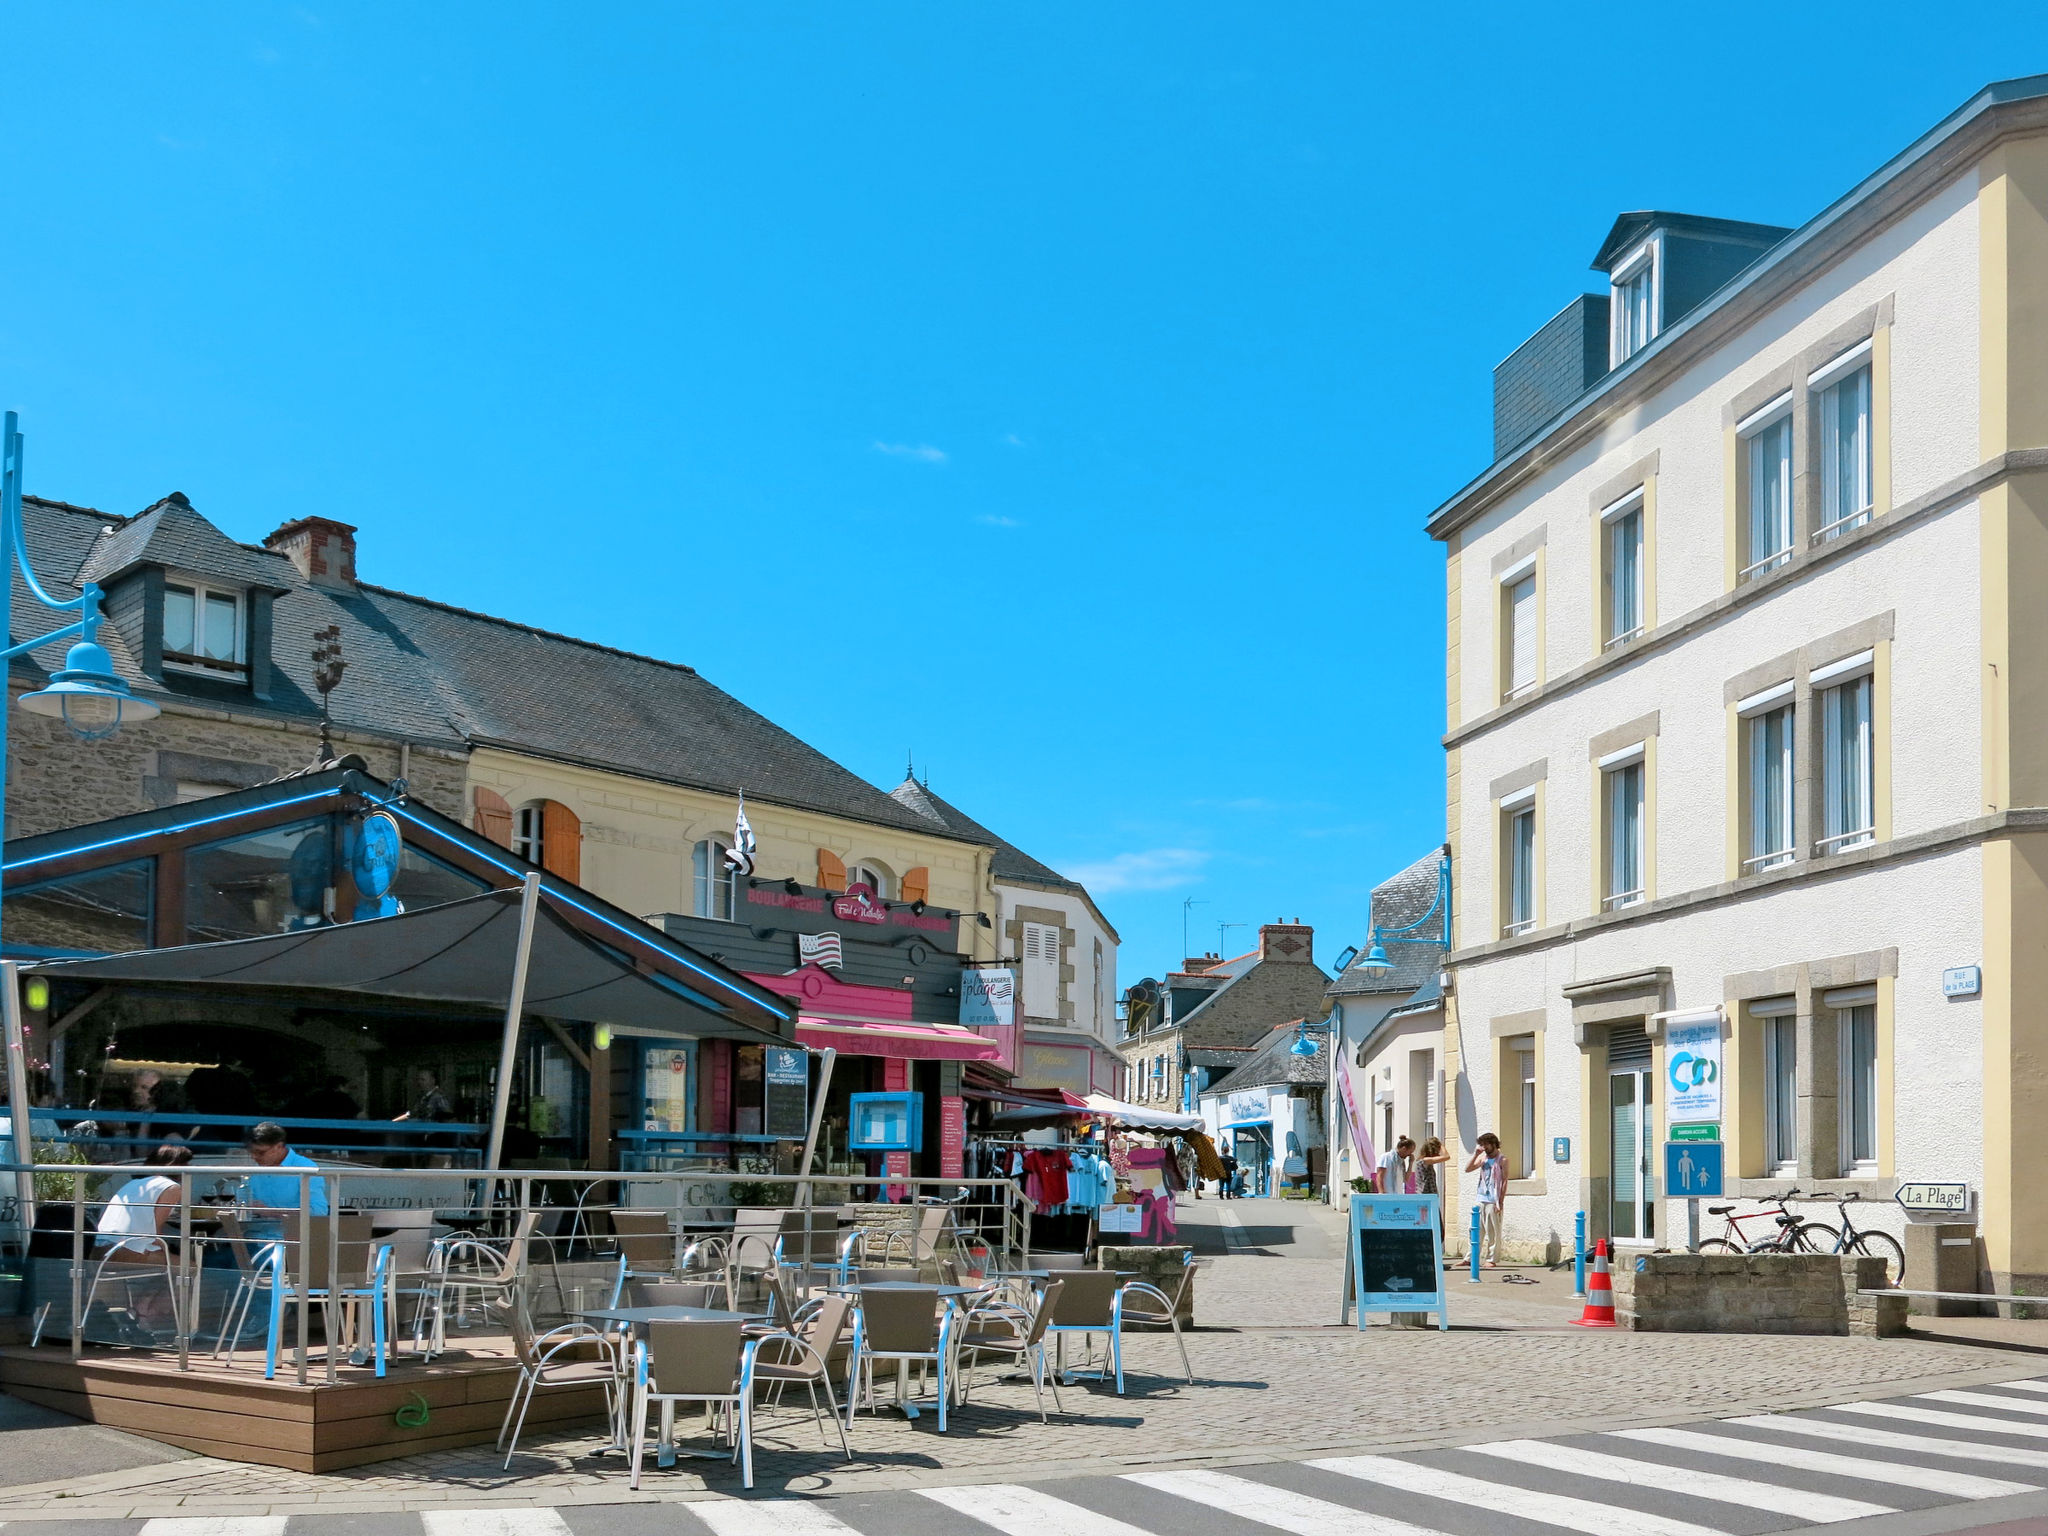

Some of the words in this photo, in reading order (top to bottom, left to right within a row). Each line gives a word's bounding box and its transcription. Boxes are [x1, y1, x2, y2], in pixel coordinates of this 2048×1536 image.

[747, 889, 824, 913] BOULANGERIE
[1953, 971, 1966, 979] RUE
[1959, 980, 1975, 989] PLAGE
[966, 973, 997, 1006] plage
[1906, 1187, 1922, 1203] La
[1927, 1187, 1961, 1208] Plage
